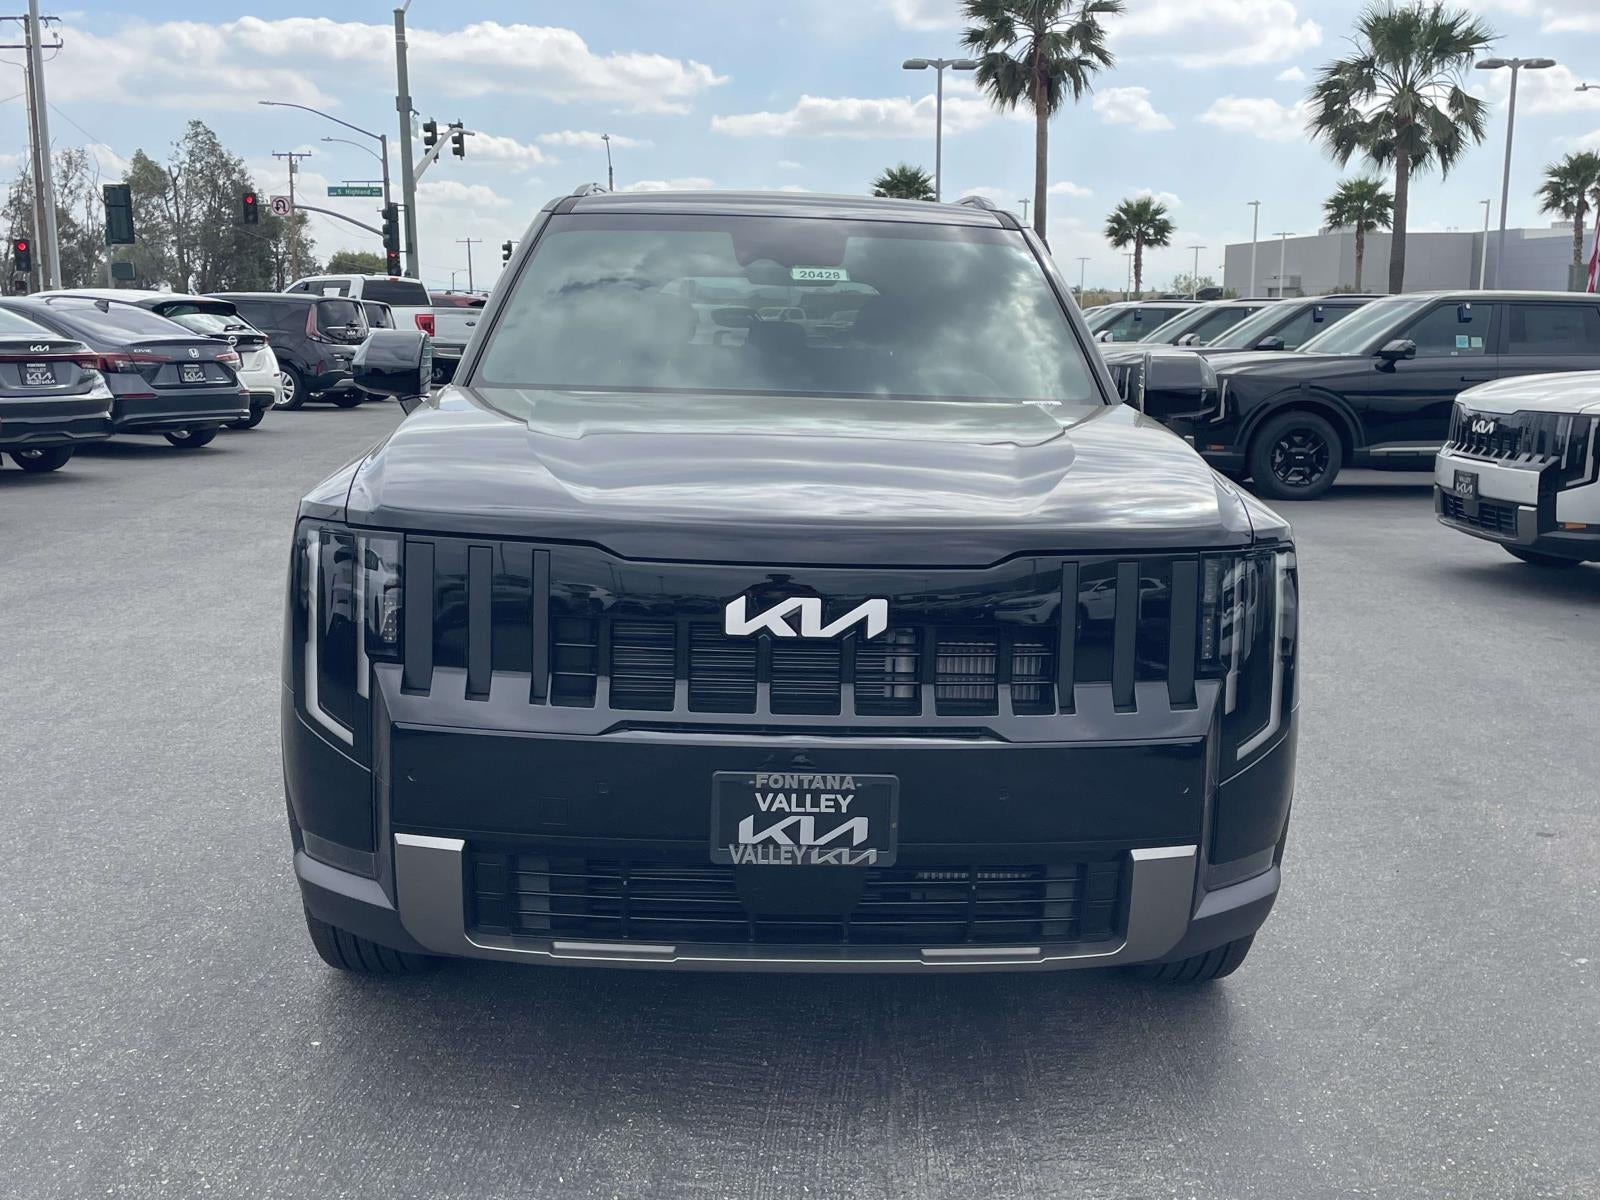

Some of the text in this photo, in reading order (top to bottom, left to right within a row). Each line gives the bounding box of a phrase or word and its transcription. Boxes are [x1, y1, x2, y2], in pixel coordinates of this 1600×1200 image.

[345, 188, 371, 196] Highland
[799, 270, 840, 279] 20428
[30, 344, 50, 352] KIA
[26, 372, 52, 380] KIA
[183, 371, 204, 380] KIA
[1472, 420, 1495, 434] KIA
[1457, 482, 1473, 494] KIA
[725, 595, 888, 639] KIA
[754, 774, 856, 790] FONTANA
[754, 792, 855, 813] VALLEY
[738, 814, 869, 847] KIA
[728, 843, 878, 865] VALLEY KIA
